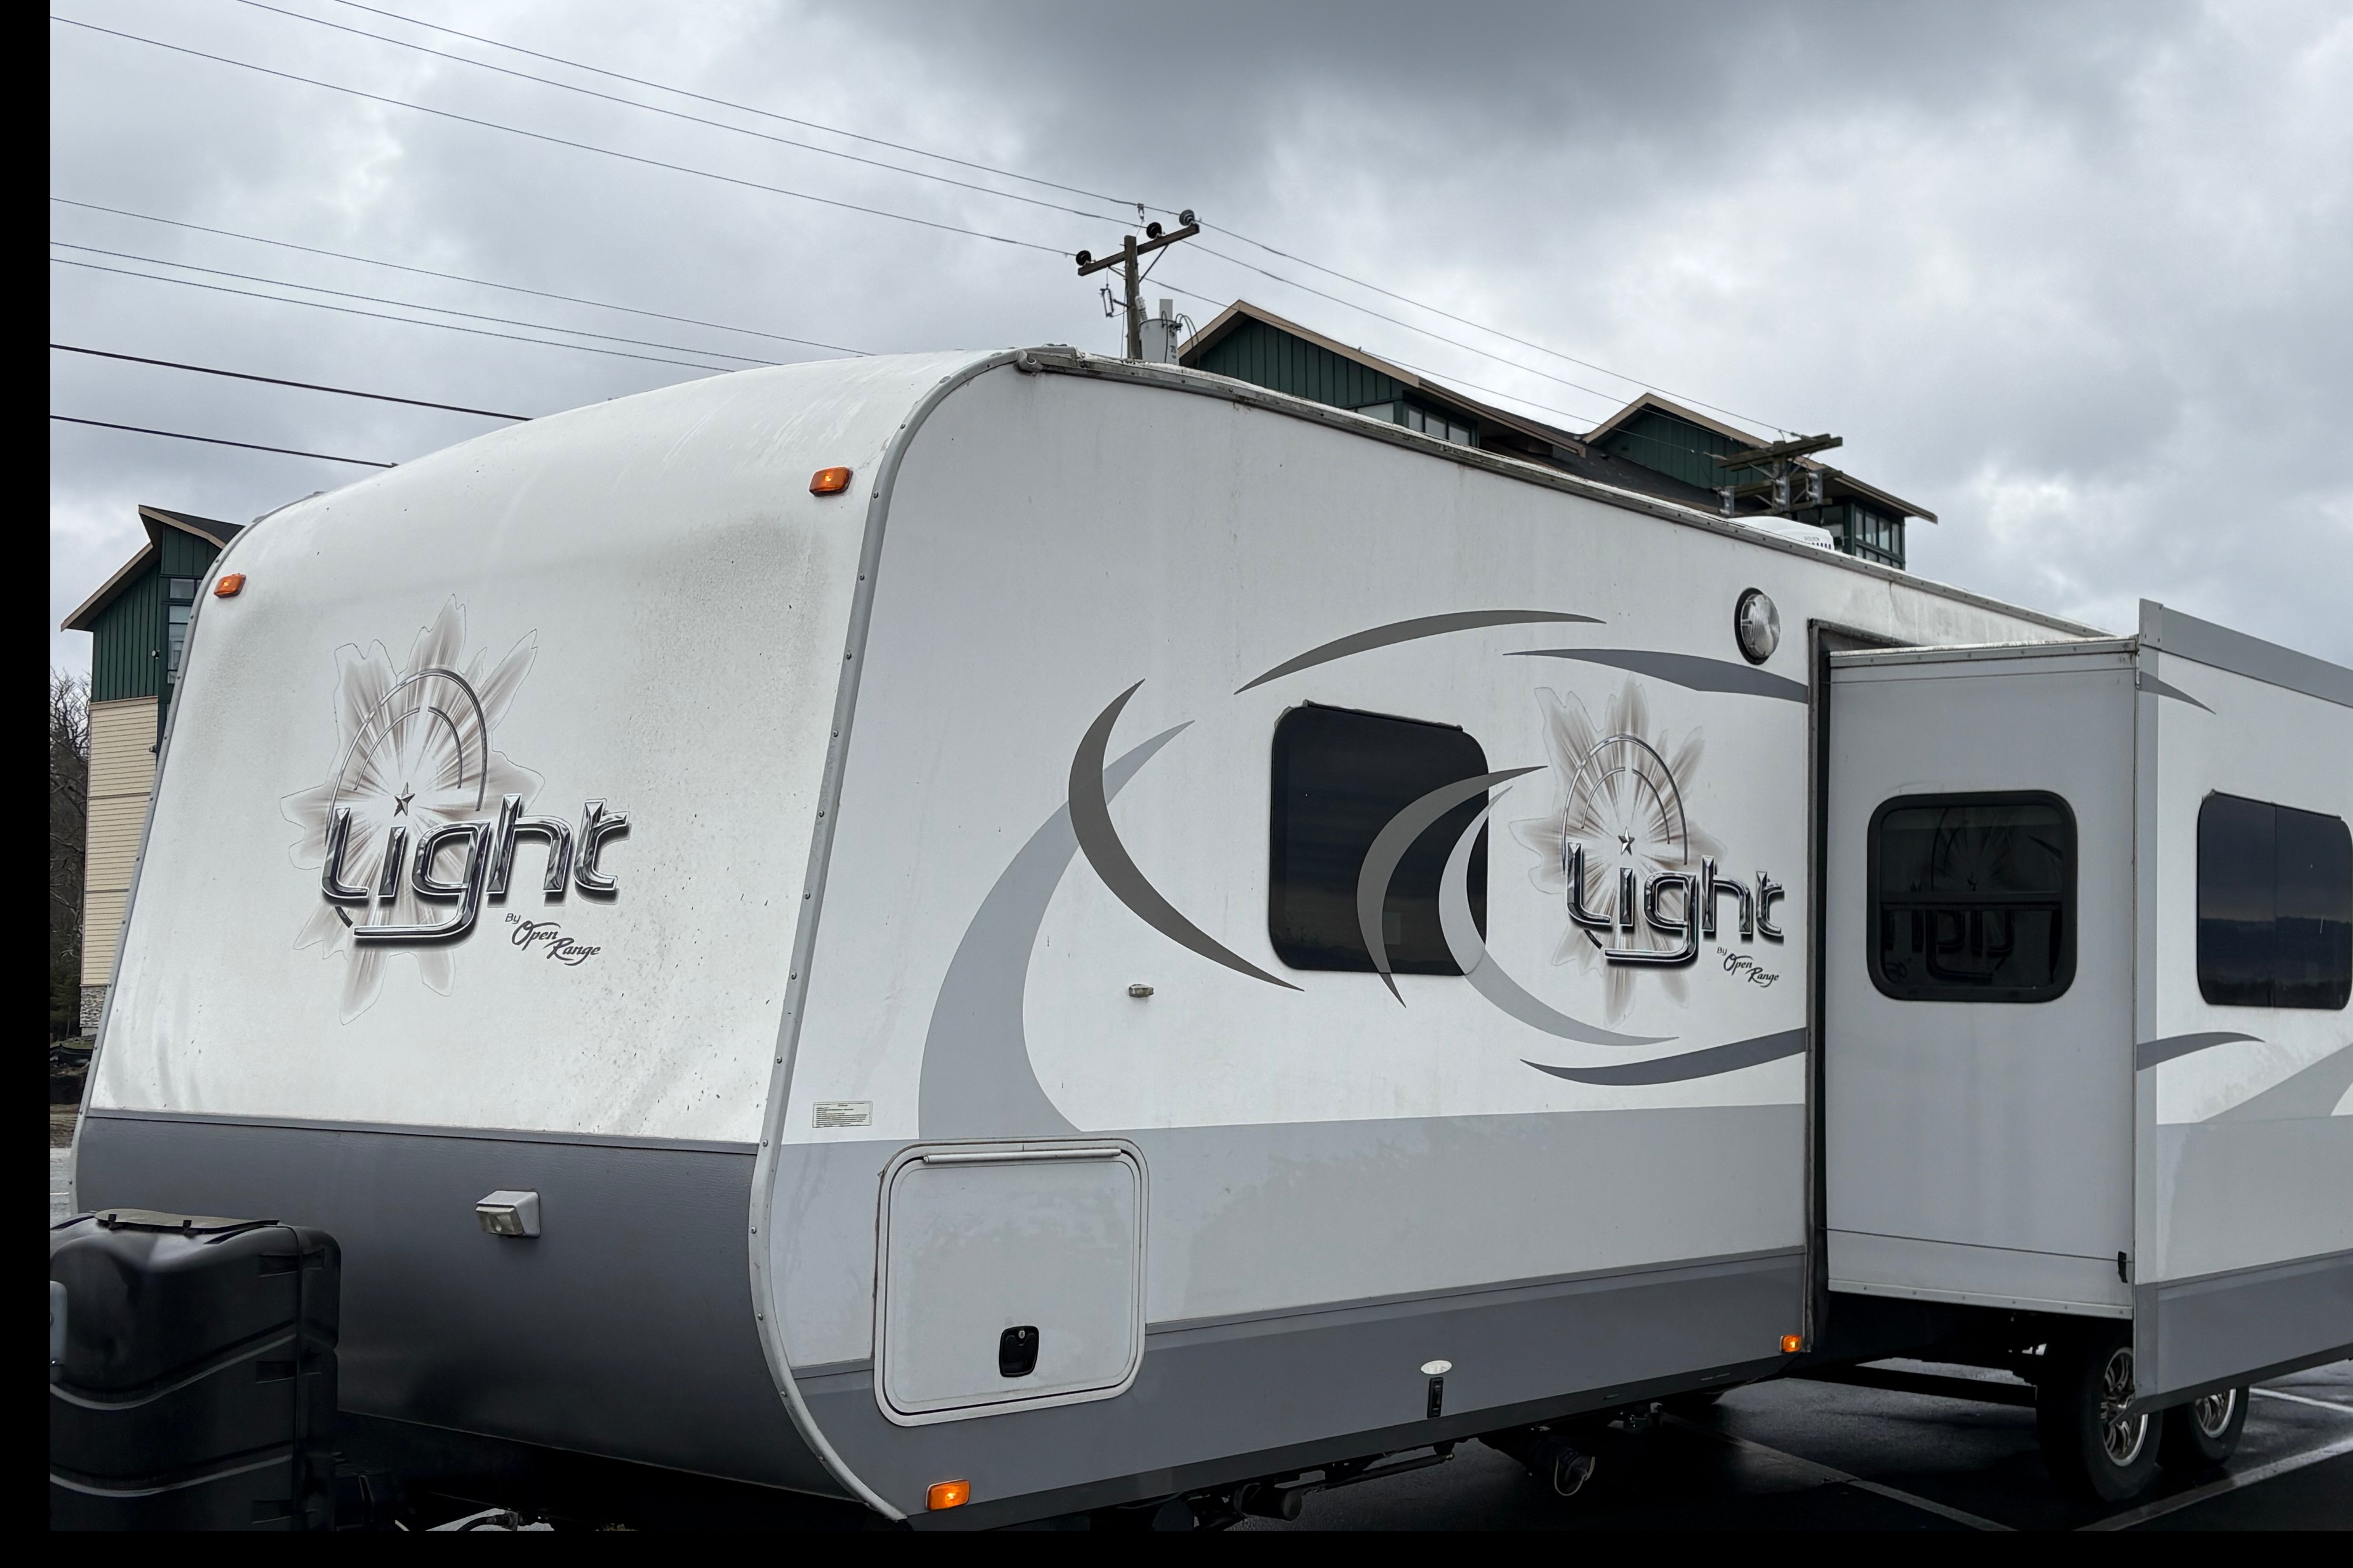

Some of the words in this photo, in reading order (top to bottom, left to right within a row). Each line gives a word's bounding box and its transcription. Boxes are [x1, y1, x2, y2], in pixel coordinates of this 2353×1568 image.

[321, 793, 630, 942] Light
[505, 913, 521, 924] By
[1566, 842, 1785, 966] Light
[512, 920, 561, 951] Open
[543, 937, 601, 966] Range
[1717, 947, 1727, 956] By
[1723, 953, 1754, 976] Open
[1745, 967, 1779, 988] Range
